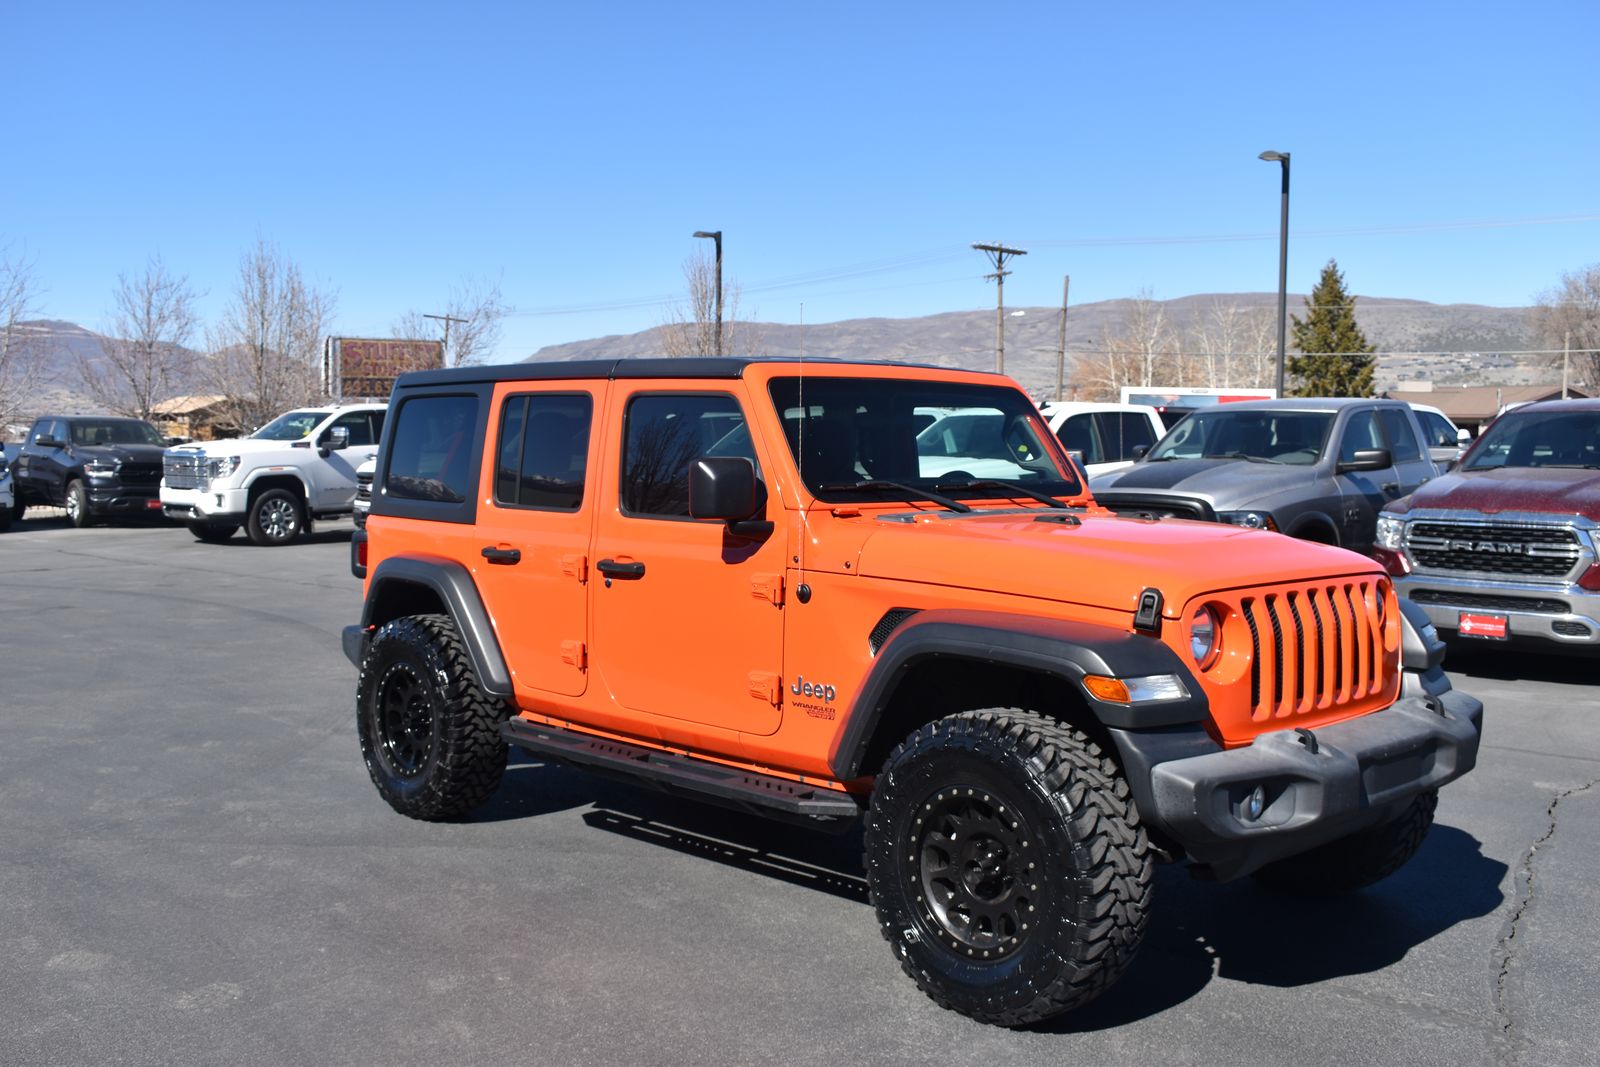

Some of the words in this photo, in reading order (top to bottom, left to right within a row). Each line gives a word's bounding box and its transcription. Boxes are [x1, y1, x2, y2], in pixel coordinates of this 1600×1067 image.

[1451, 539, 1522, 553] RAM
[791, 675, 836, 704] Jeep
[791, 700, 836, 714] WRANGLER
